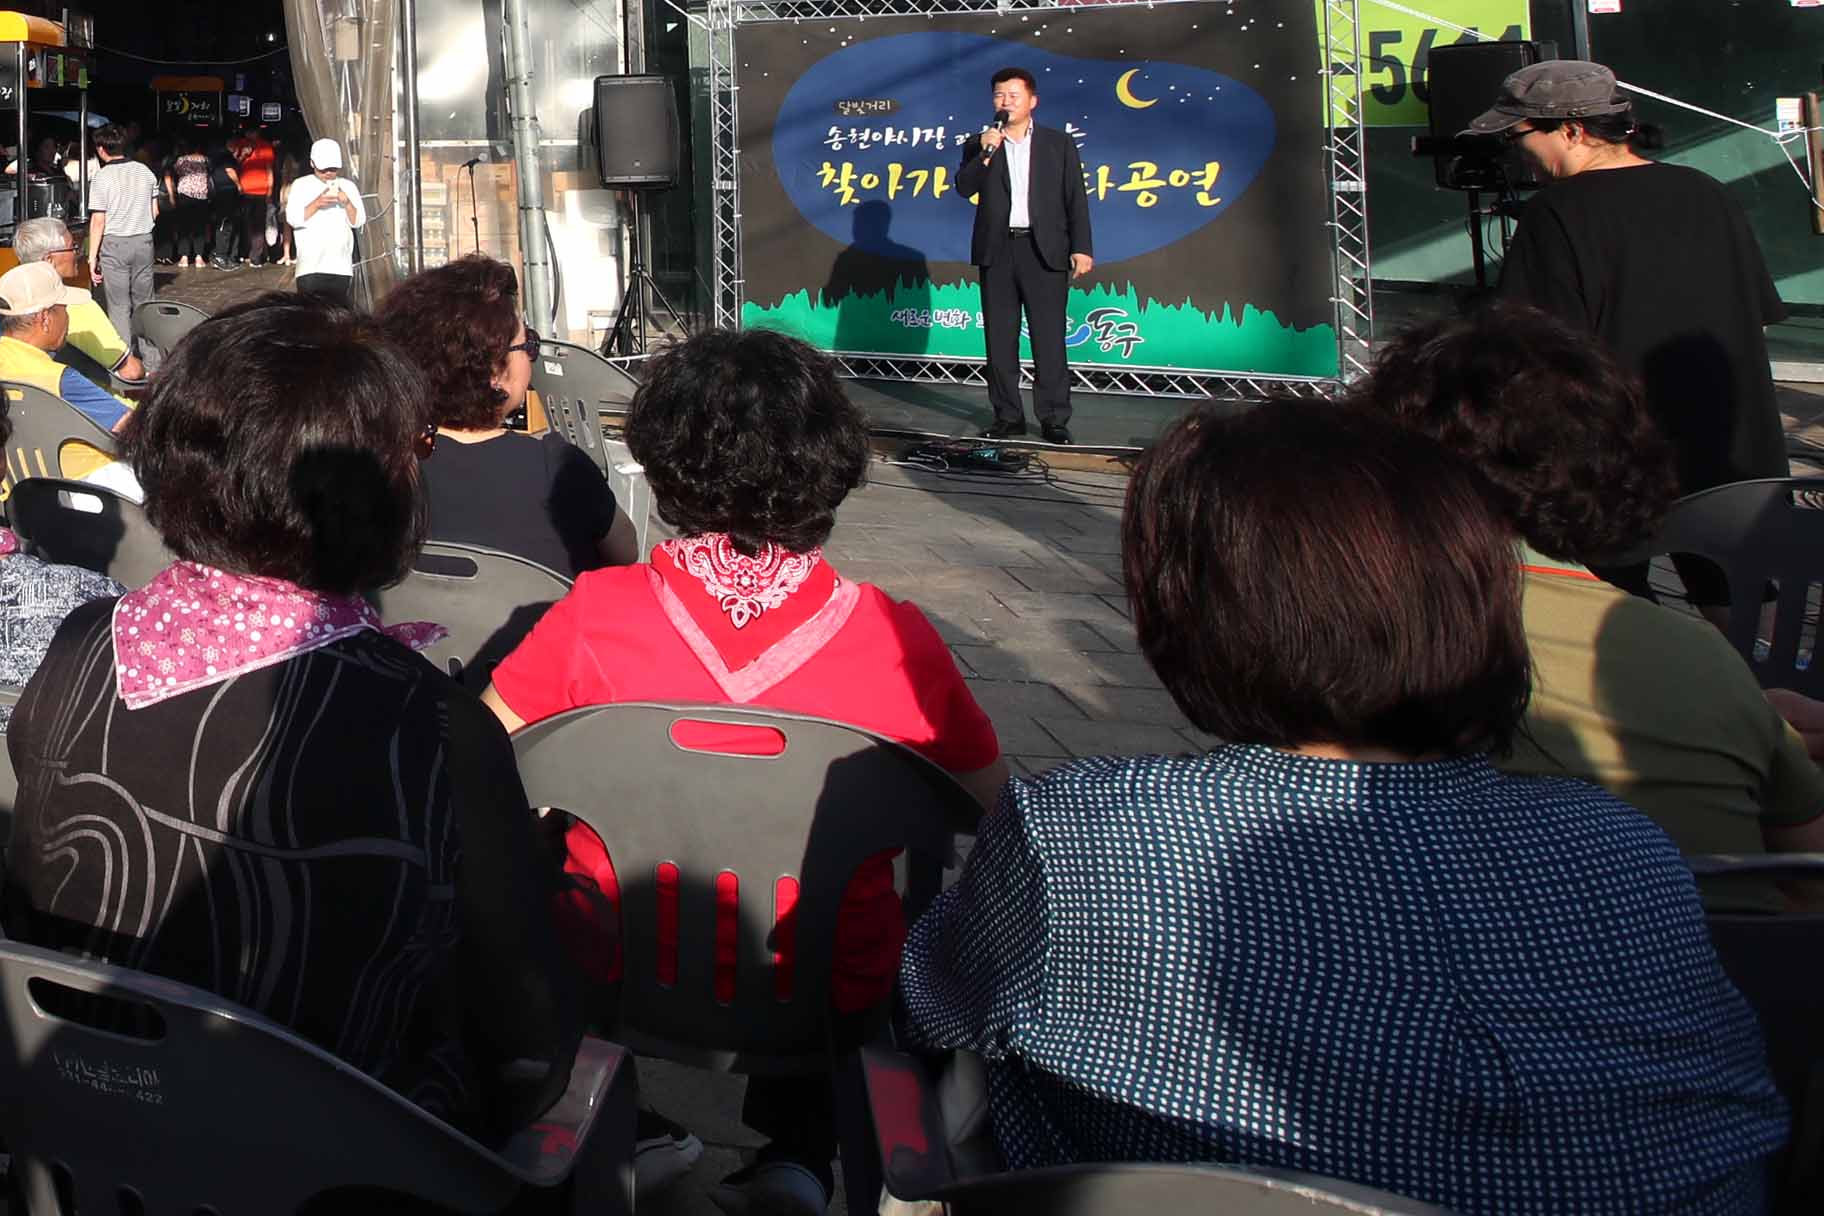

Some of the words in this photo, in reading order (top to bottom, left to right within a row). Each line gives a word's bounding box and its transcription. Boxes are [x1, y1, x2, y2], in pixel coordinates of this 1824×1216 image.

[838, 99, 892, 116] 달빛거리
[823, 125, 946, 151] 송현야시장
[816, 160, 966, 207] 찾아가
[890, 307, 933, 328] 새로운
[933, 308, 971, 330] 변화
[1086, 306, 1146, 360] 동구
